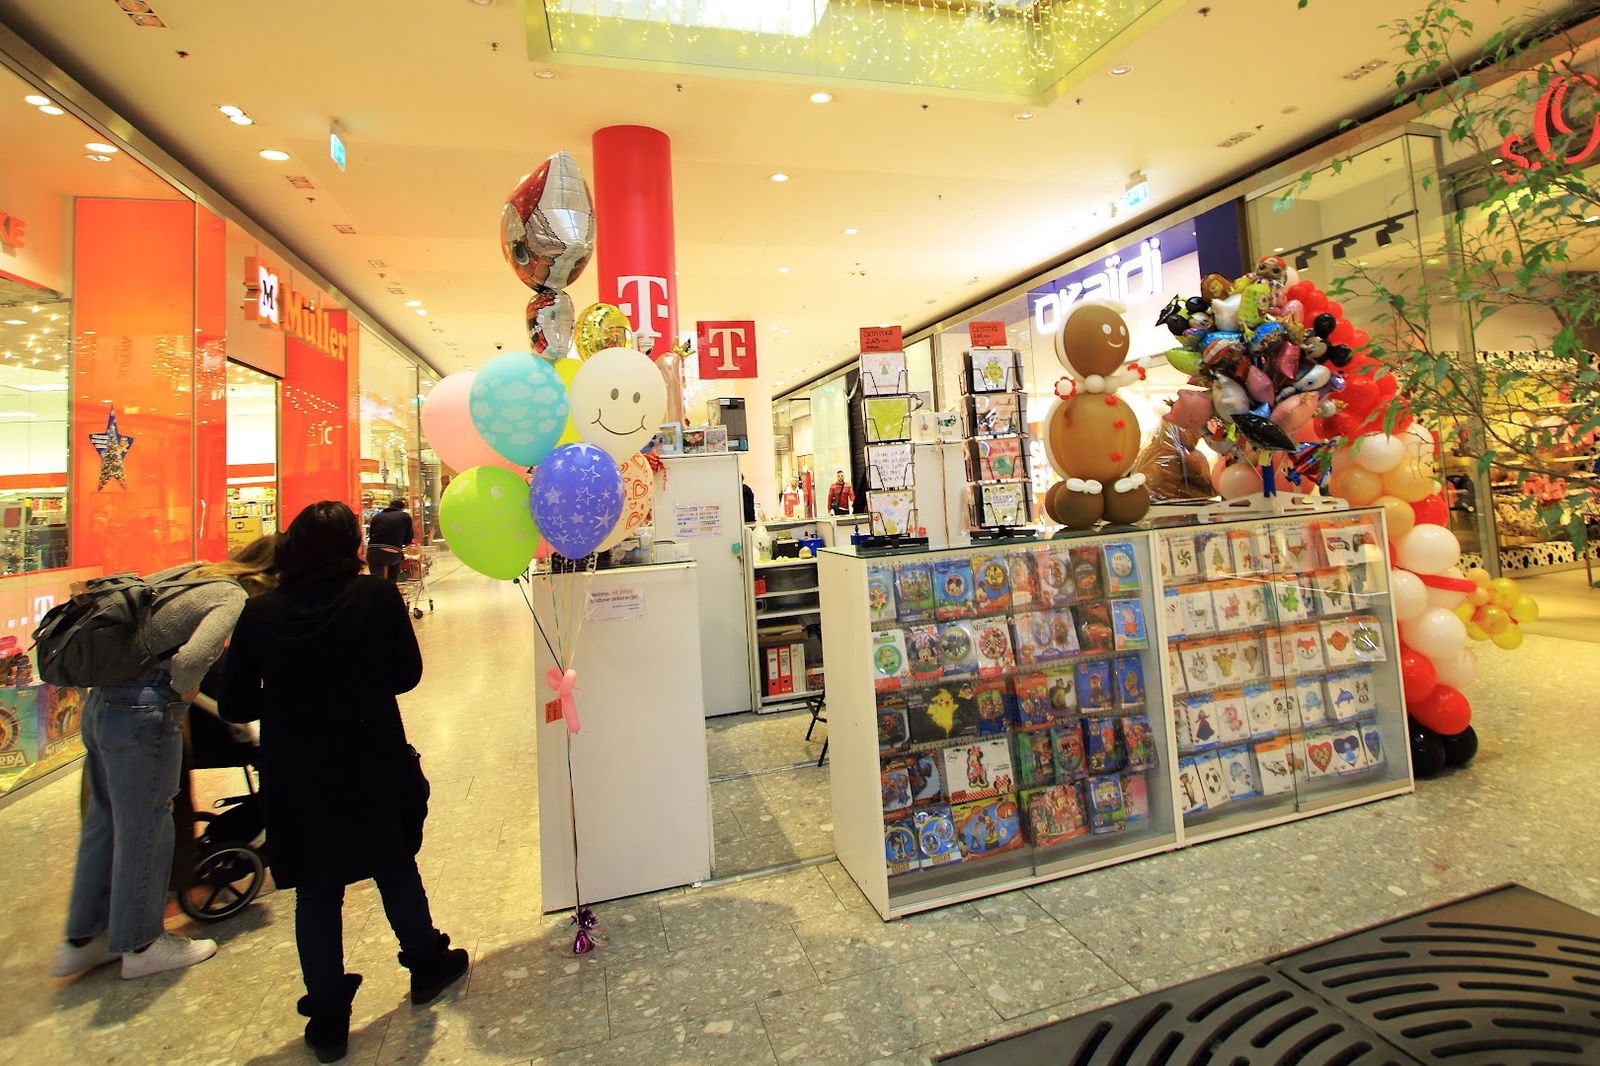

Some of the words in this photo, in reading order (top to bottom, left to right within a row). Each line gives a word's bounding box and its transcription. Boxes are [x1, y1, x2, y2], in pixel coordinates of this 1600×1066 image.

[283, 281, 347, 362] Müller
[617, 275, 668, 338] T
[708, 328, 746, 371] T
